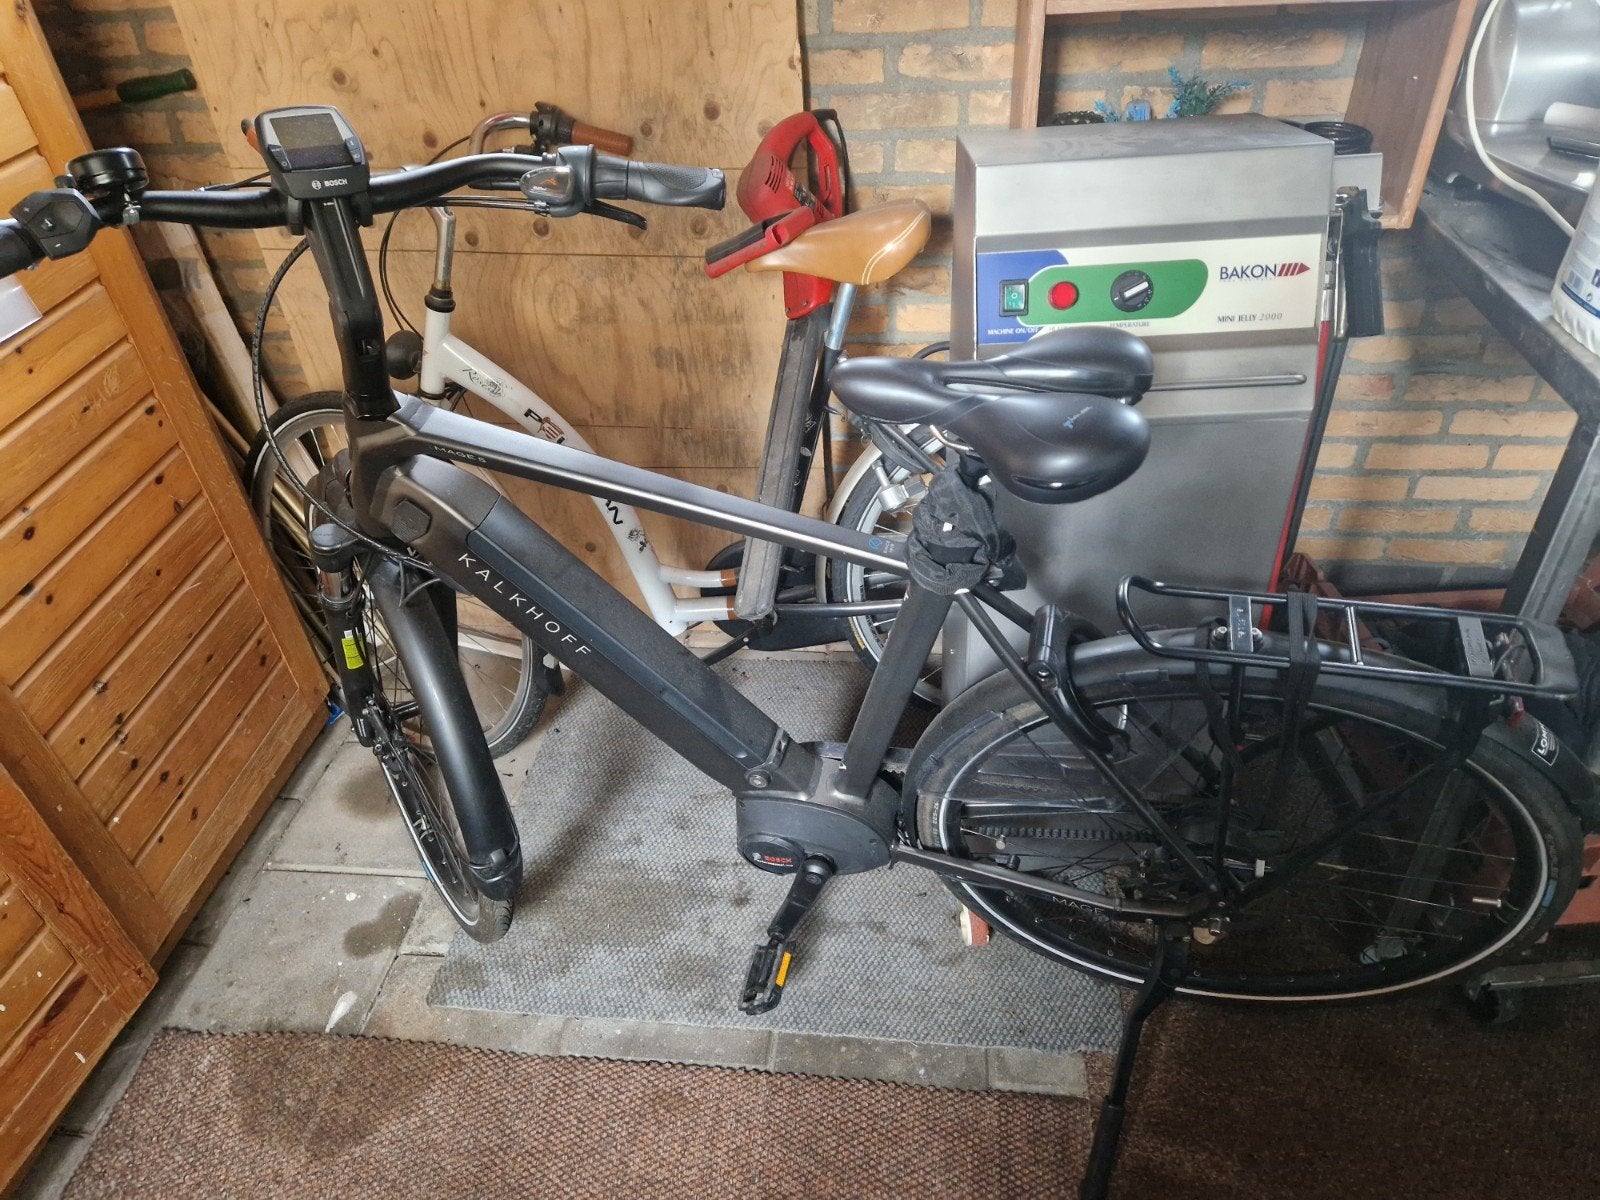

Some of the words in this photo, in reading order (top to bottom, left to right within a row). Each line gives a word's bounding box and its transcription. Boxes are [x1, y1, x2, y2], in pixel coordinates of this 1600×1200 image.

[324, 178, 348, 188] BOSCH
[1219, 264, 1277, 280] BAKON
[1217, 314, 1235, 323] MINI
[1238, 314, 1258, 322] JELLY
[1259, 312, 1283, 321] 2000
[458, 553, 592, 655] KALKHOFF
[764, 855, 792, 863] BOSCH
